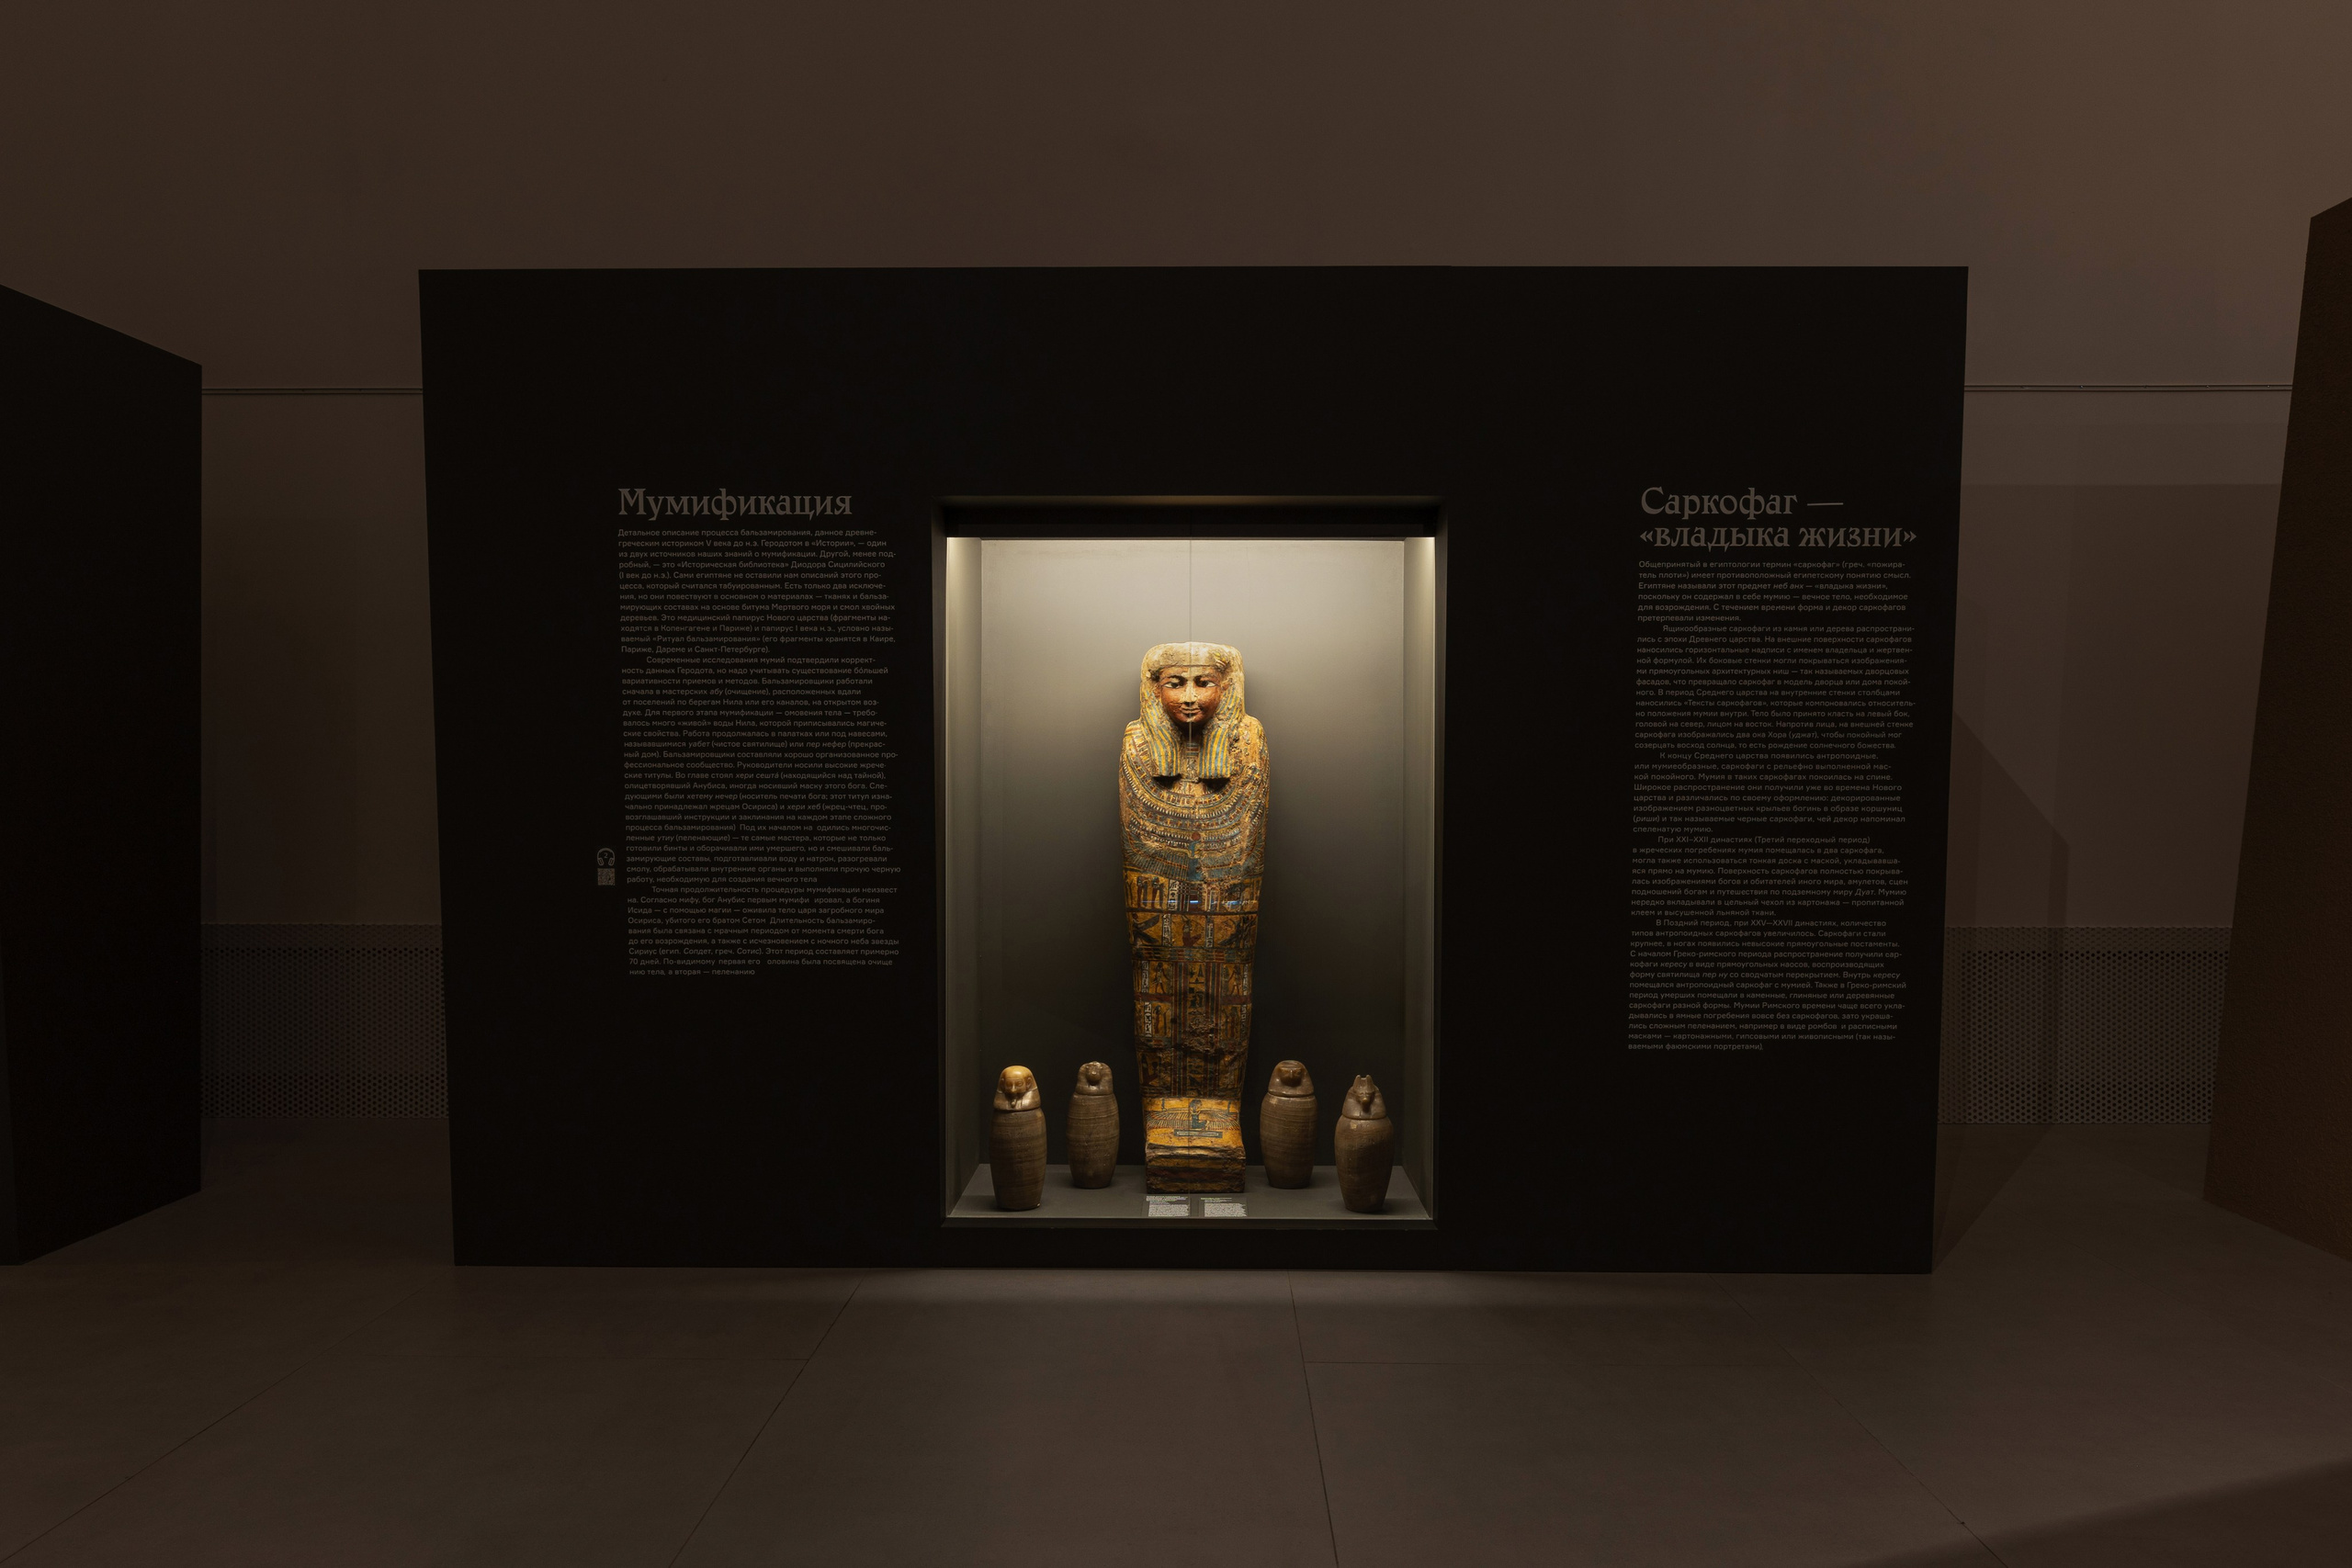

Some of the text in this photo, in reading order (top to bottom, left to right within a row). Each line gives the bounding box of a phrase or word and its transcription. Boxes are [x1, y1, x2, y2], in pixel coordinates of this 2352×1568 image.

[618, 488, 853, 521] Мумификация
[1641, 486, 1798, 520] Саркофаг
[618, 529, 660, 537] Детальное
[1640, 526, 1917, 552] «владыка жизни»
[761, 550, 818, 558] мумификации.
[1638, 561, 1701, 569] Общепринятый
[646, 582, 680, 590] который
[719, 582, 782, 590] табуированным.
[742, 603, 770, 611] битума
[771, 603, 809, 611] Мертвого
[1797, 604, 1823, 612] форма
[1859, 604, 1906, 612] саркофагов
[655, 645, 686, 654] Дареме
[694, 645, 770, 654] Санкт-Петербурге).
[646, 656, 701, 664] Современные
[760, 656, 785, 664] мумий
[762, 677, 834, 686] Бальзамировщики
[836, 677, 873, 686] работали
[1694, 752, 1734, 760] Среднего
[737, 761, 793, 769] Руководители
[1633, 804, 1694, 813] изображением
[1830, 805, 1859, 813] образе
[1658, 836, 1674, 844] При
[653, 865, 709, 873] обрабатывали
[1854, 888, 1876, 896] Дуат.
[1878, 888, 1907, 897] Мумию
[1818, 930, 1861, 938] Саркофаги
